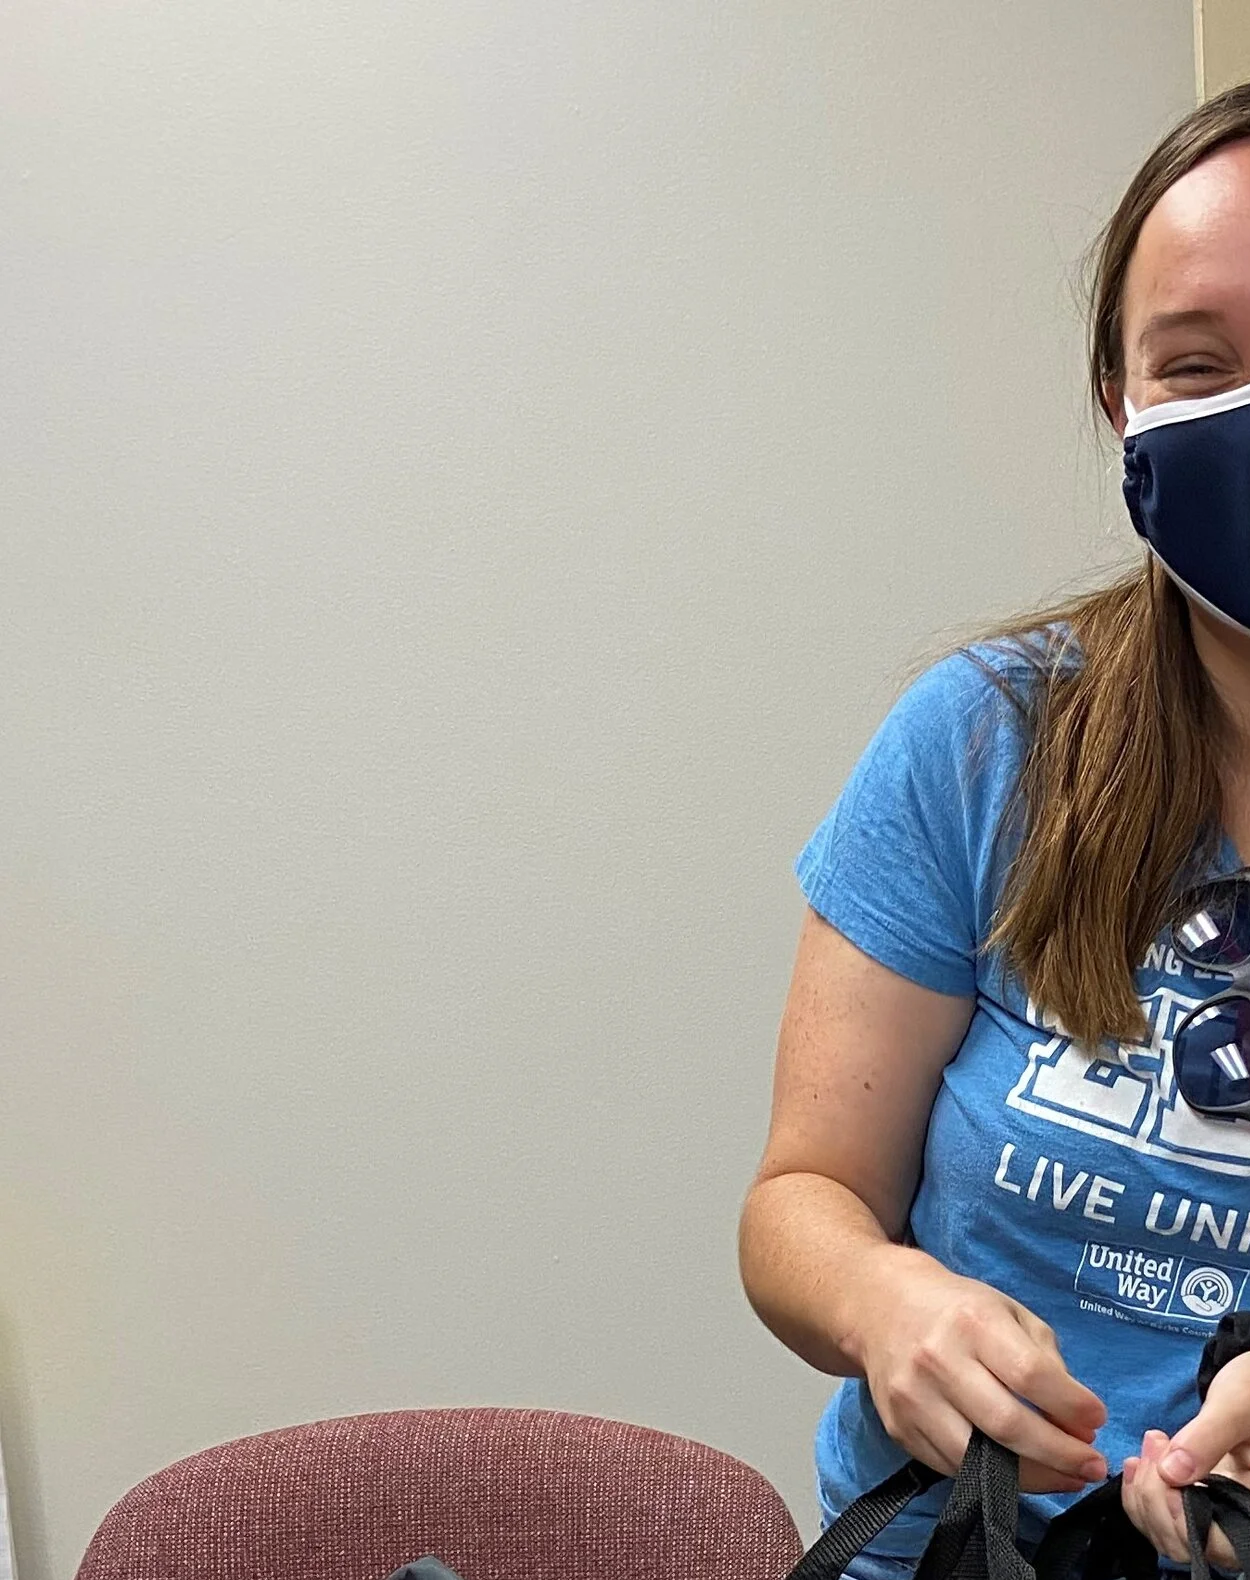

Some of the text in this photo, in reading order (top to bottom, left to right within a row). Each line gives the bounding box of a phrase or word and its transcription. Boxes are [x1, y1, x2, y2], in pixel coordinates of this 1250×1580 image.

[995, 1143, 1125, 1223] LIVE
[1089, 1244, 1174, 1282] United
[1079, 1300, 1114, 1317] United
[1117, 1273, 1168, 1309] Way
